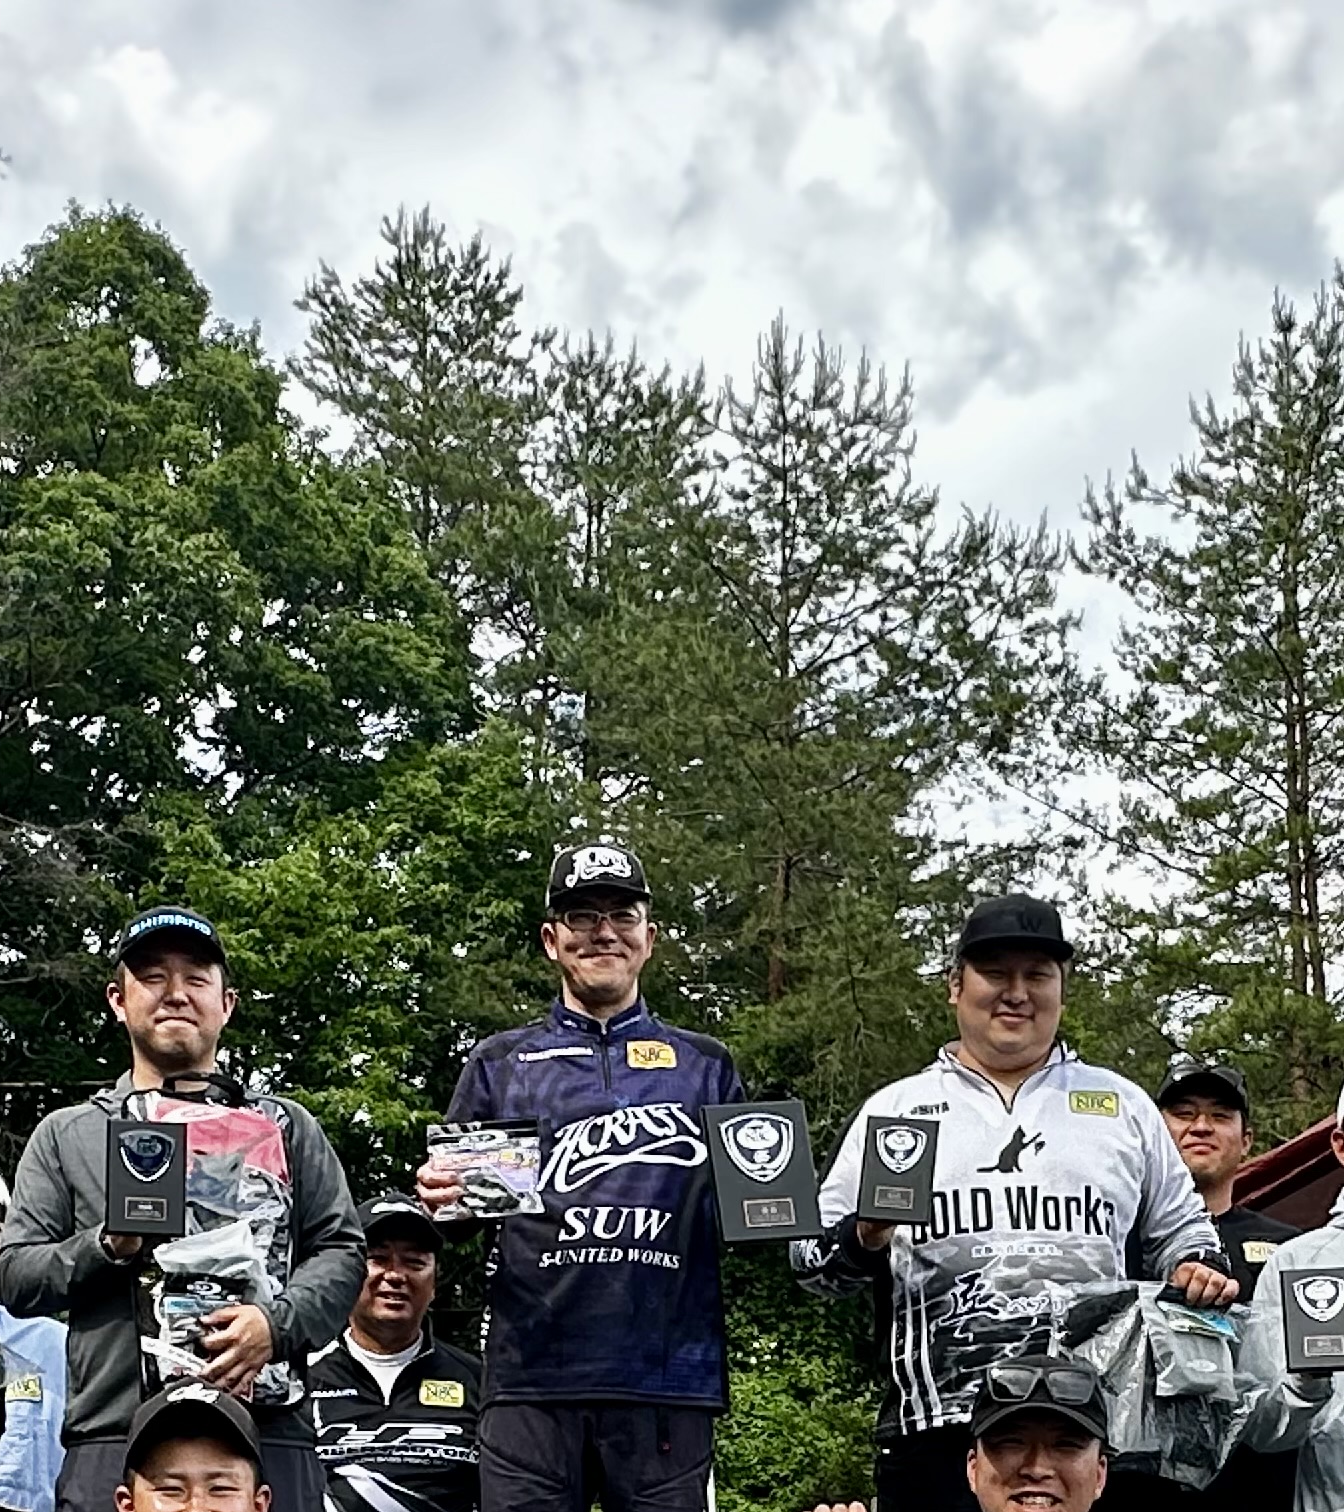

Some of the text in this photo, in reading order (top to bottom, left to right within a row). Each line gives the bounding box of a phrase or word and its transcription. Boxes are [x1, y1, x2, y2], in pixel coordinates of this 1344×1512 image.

[558, 1206, 673, 1242] SUW
[912, 1188, 993, 1246] OLD
[538, 1247, 682, 1270] S-UNITED WORKS
